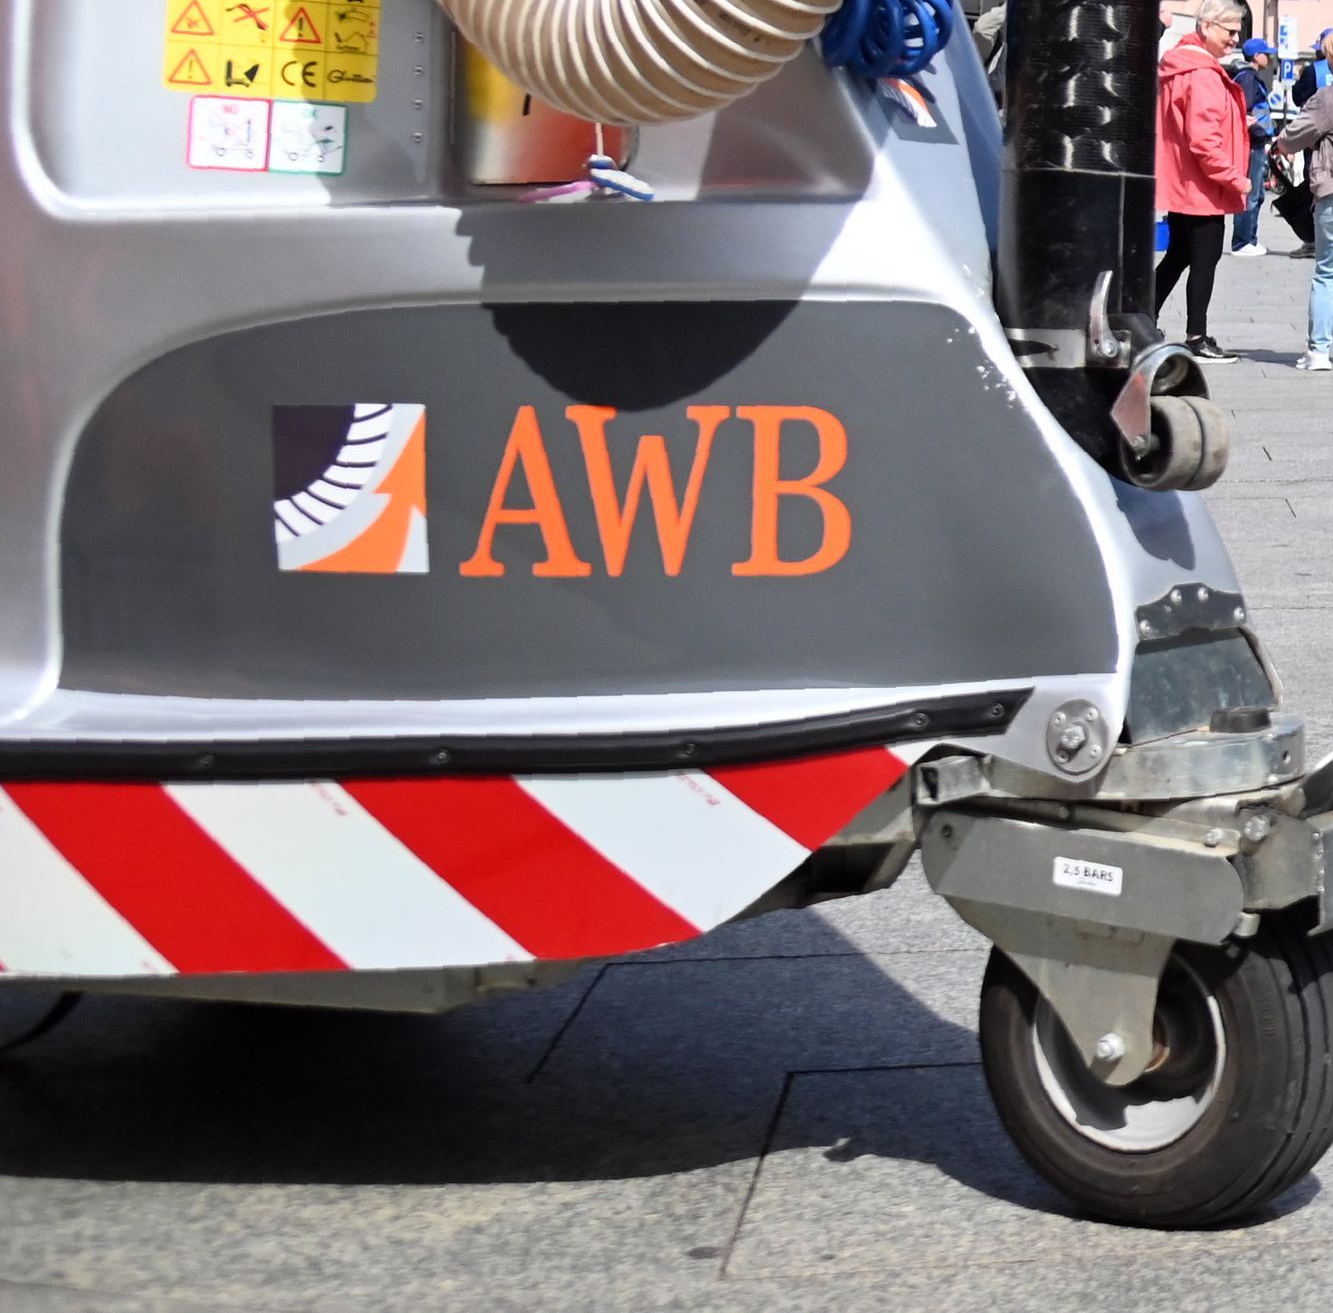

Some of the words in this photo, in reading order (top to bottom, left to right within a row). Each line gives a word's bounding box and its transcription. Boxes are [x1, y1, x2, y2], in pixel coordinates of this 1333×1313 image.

[1283, 61, 1292, 79] P
[458, 404, 852, 577] AWB
[1063, 863, 1080, 877] 2,5
[1083, 866, 1115, 882] BARS
